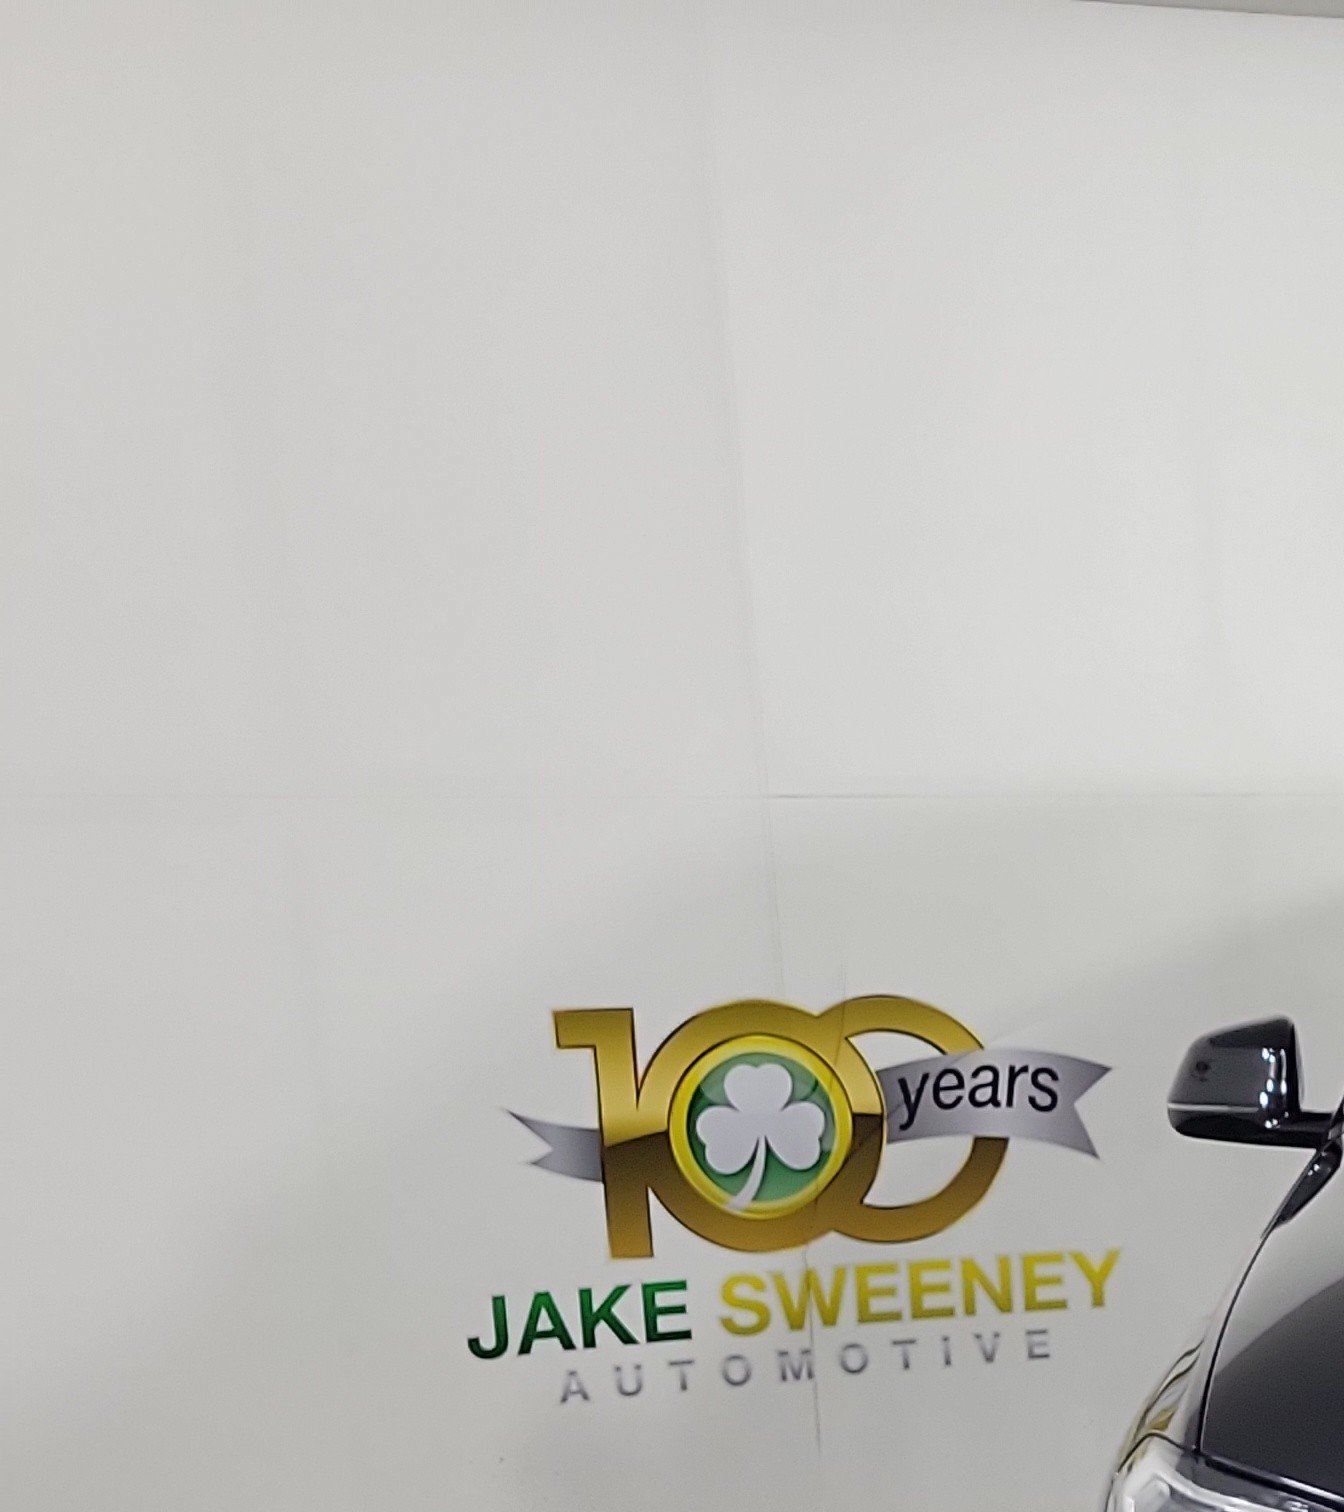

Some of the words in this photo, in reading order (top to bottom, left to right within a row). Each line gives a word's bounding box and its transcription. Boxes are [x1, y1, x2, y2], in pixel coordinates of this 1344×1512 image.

[552, 994, 1009, 1258] 100
[899, 1063, 1060, 1131] years
[467, 1279, 693, 1361] JAKE
[719, 1249, 1122, 1336] SWEENEY
[559, 1329, 1051, 1404] AUTOMOTIVE
